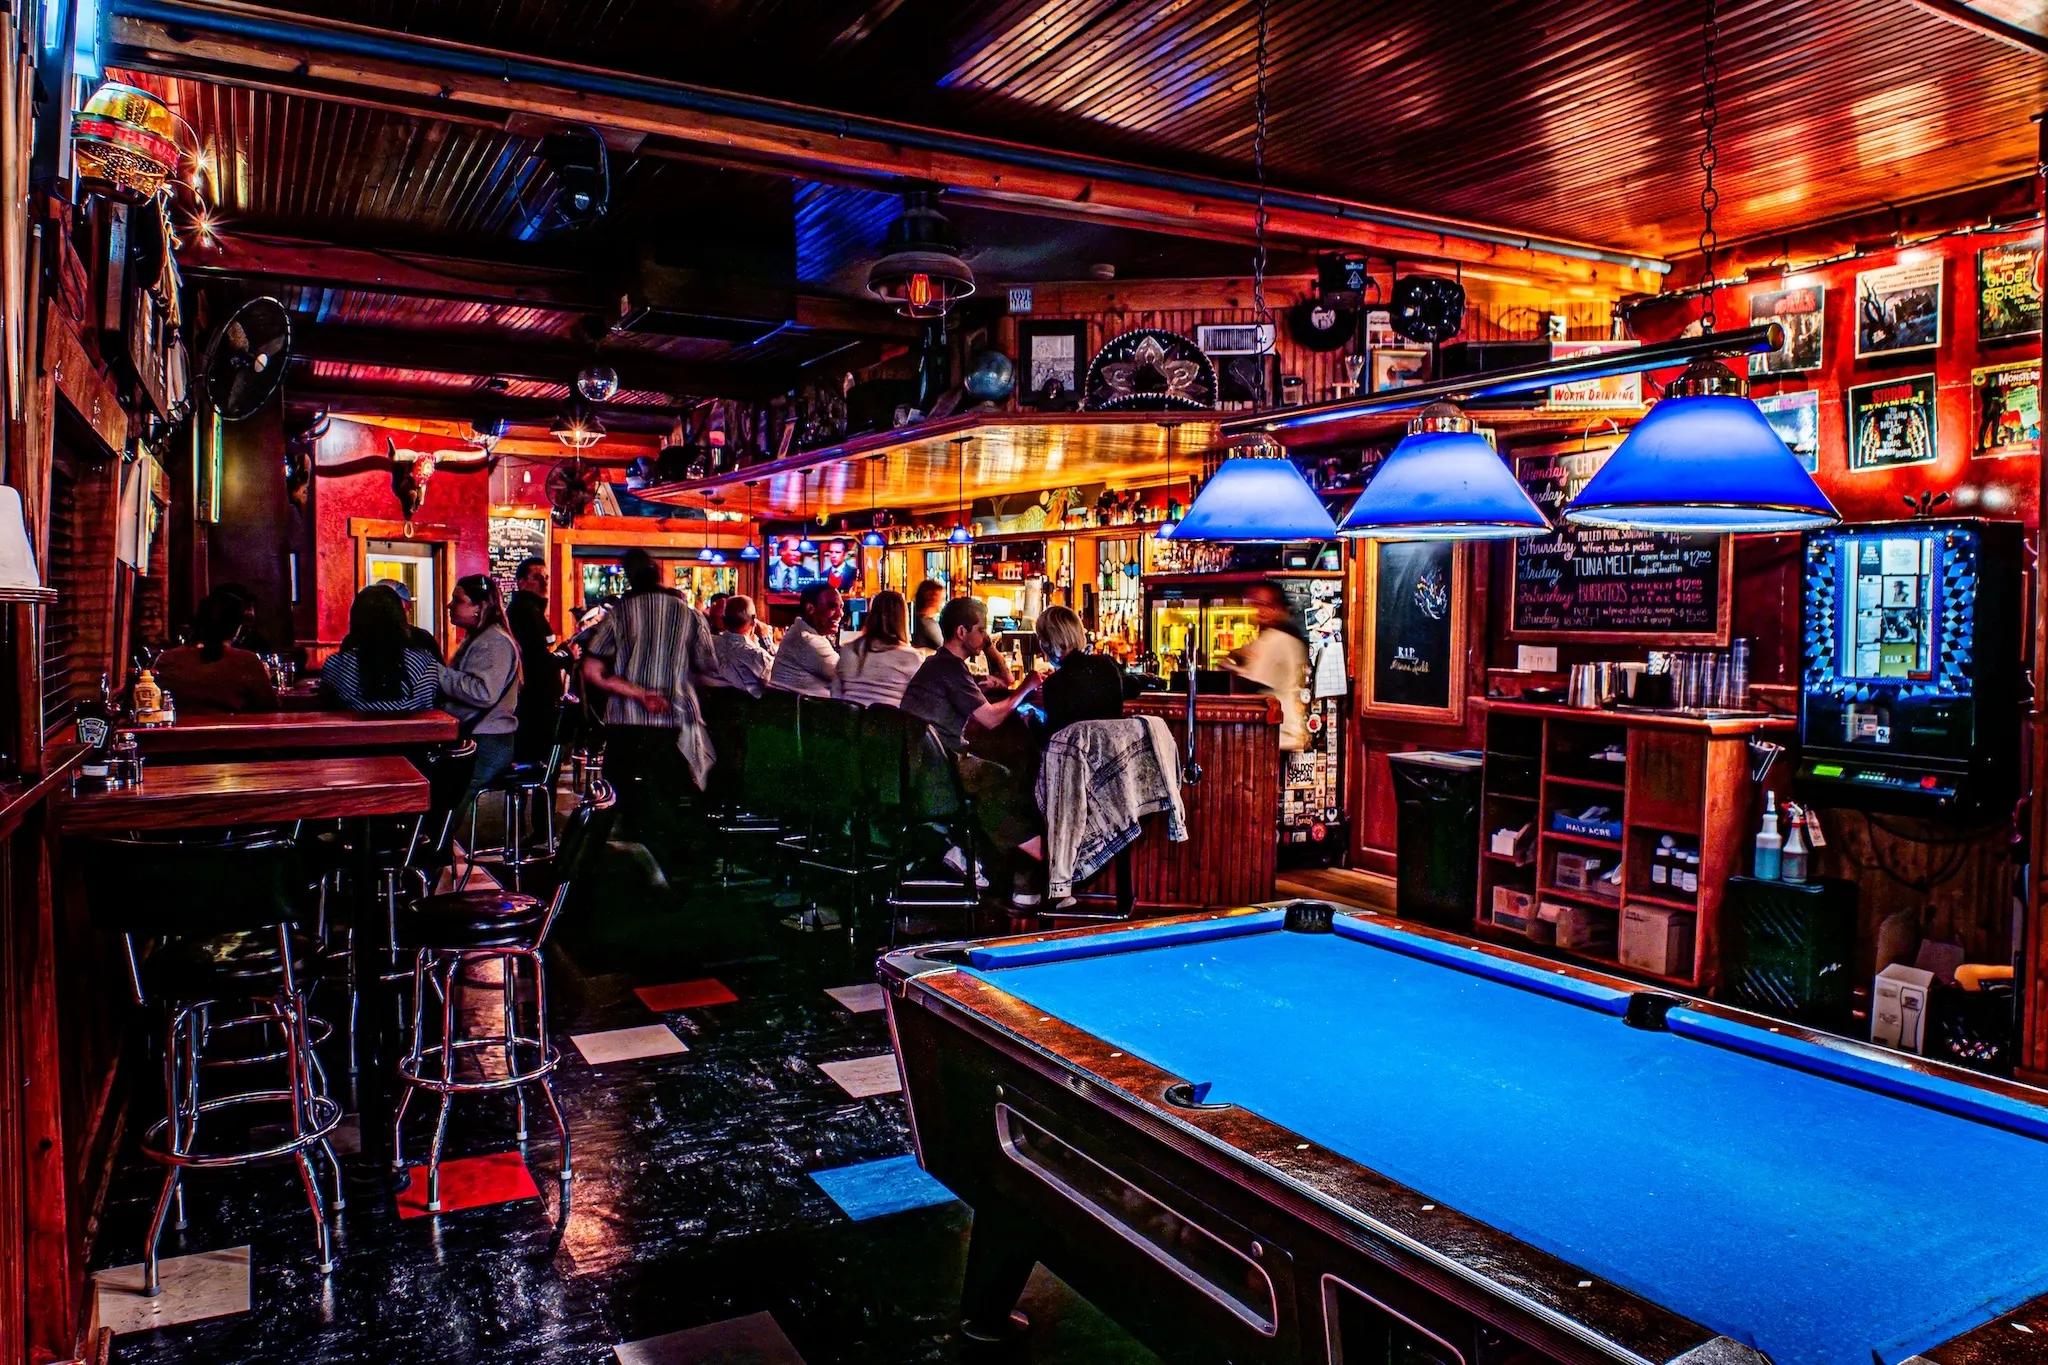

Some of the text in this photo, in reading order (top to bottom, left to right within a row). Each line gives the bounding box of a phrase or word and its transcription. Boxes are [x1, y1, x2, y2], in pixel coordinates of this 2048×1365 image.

[1986, 266, 2029, 288] GHOST
[1982, 281, 2032, 303] STORIES
[2019, 302, 2040, 312] YOUNG
[1998, 371, 2040, 386] MONSTERS
[1554, 389, 1634, 401] WORTH DRINKING
[1521, 457, 1570, 486] Monday
[1519, 533, 1576, 561] Thursday
[1578, 530, 1601, 542] PULLED
[1603, 529, 1619, 540] PORK
[1632, 541, 1655, 553] pickles
[1641, 553, 1658, 562] open
[1660, 549, 1679, 560] faced
[1518, 555, 1635, 587] Friday TUNA MELT
[1518, 583, 1574, 609] Saturday
[1578, 583, 1627, 603] BURRITOS
[1631, 582, 1672, 590] CHICKEN
[1565, 823, 1611, 837] HALF ACRE
